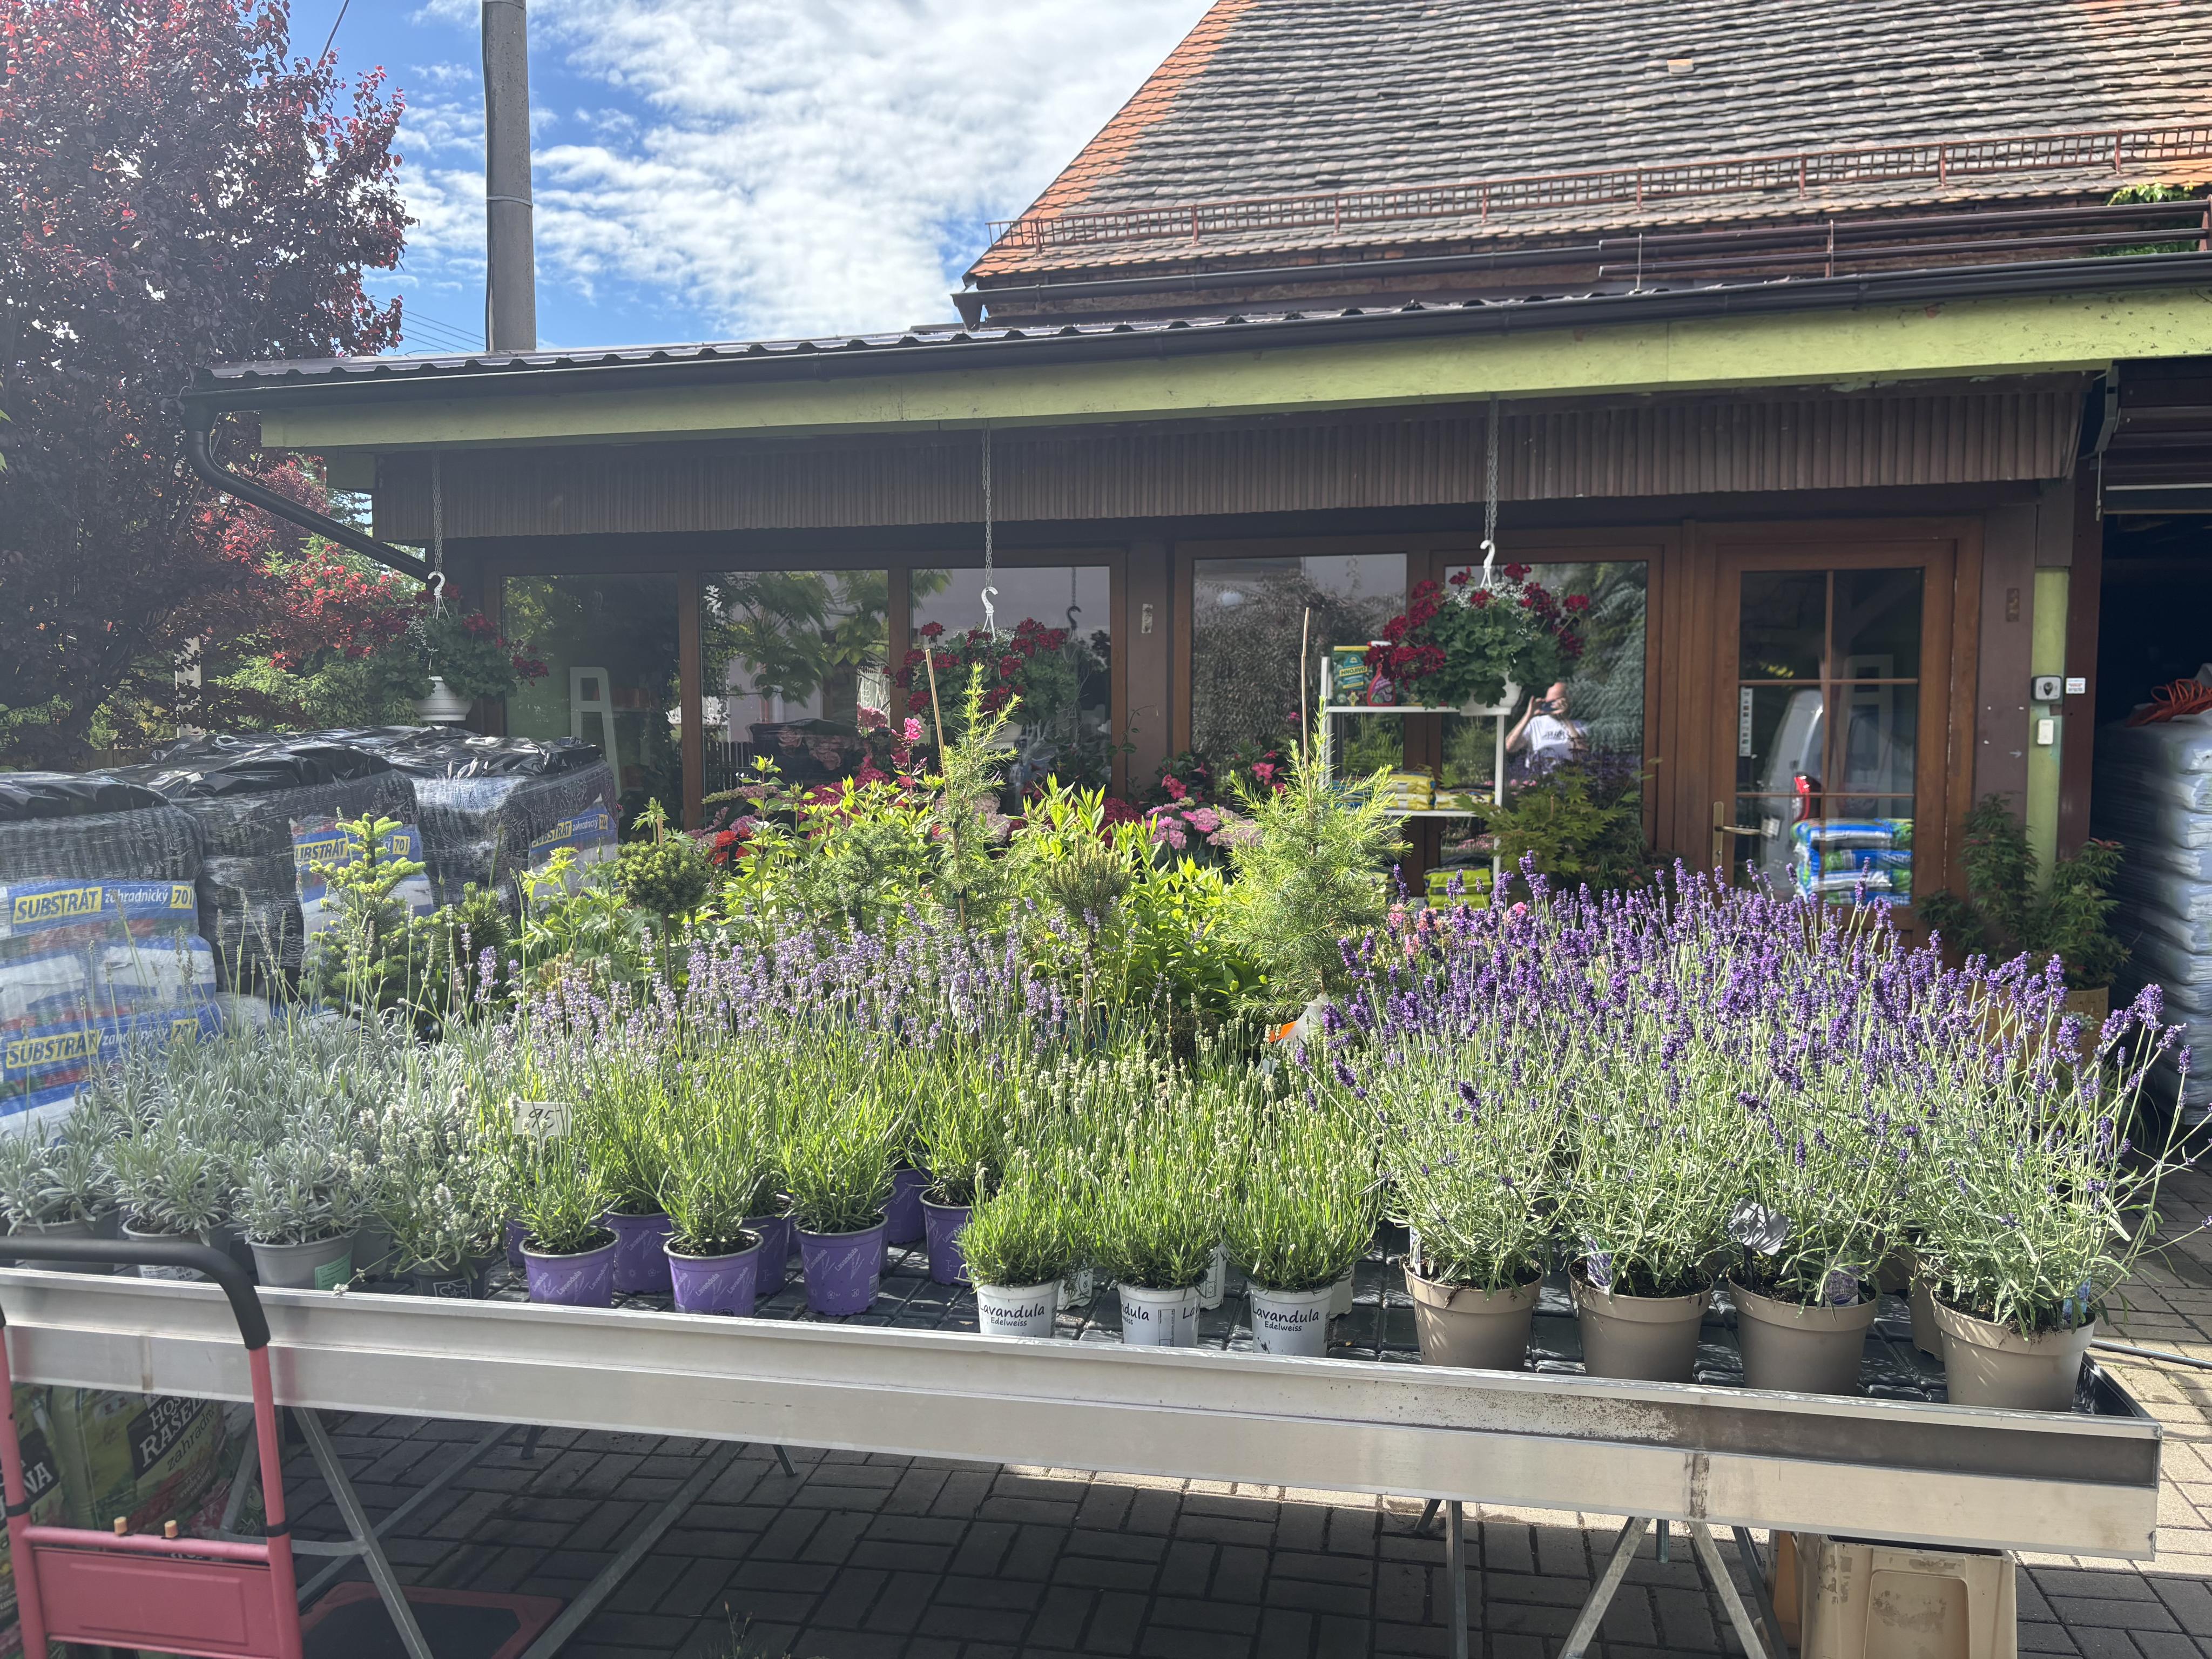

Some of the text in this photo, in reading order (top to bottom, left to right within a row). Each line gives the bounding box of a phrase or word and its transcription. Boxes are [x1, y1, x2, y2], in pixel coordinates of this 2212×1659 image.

[17, 888, 99, 921] SUBSTRÁT
[834, 1247, 859, 1271] Lavandula
[556, 1270, 582, 1295] Lavandula
[589, 1263, 609, 1290] Lavandula
[695, 1273, 720, 1296] Lavandula
[727, 1267, 748, 1294] Lavandula
[980, 1297, 1044, 1318] Lavandula
[1252, 1301, 1319, 1323] Lavandula
[991, 1317, 1027, 1326] Edelweiss
[1265, 1321, 1302, 1331] Edelweiss
[139, 1398, 205, 1468] RAŠEL
